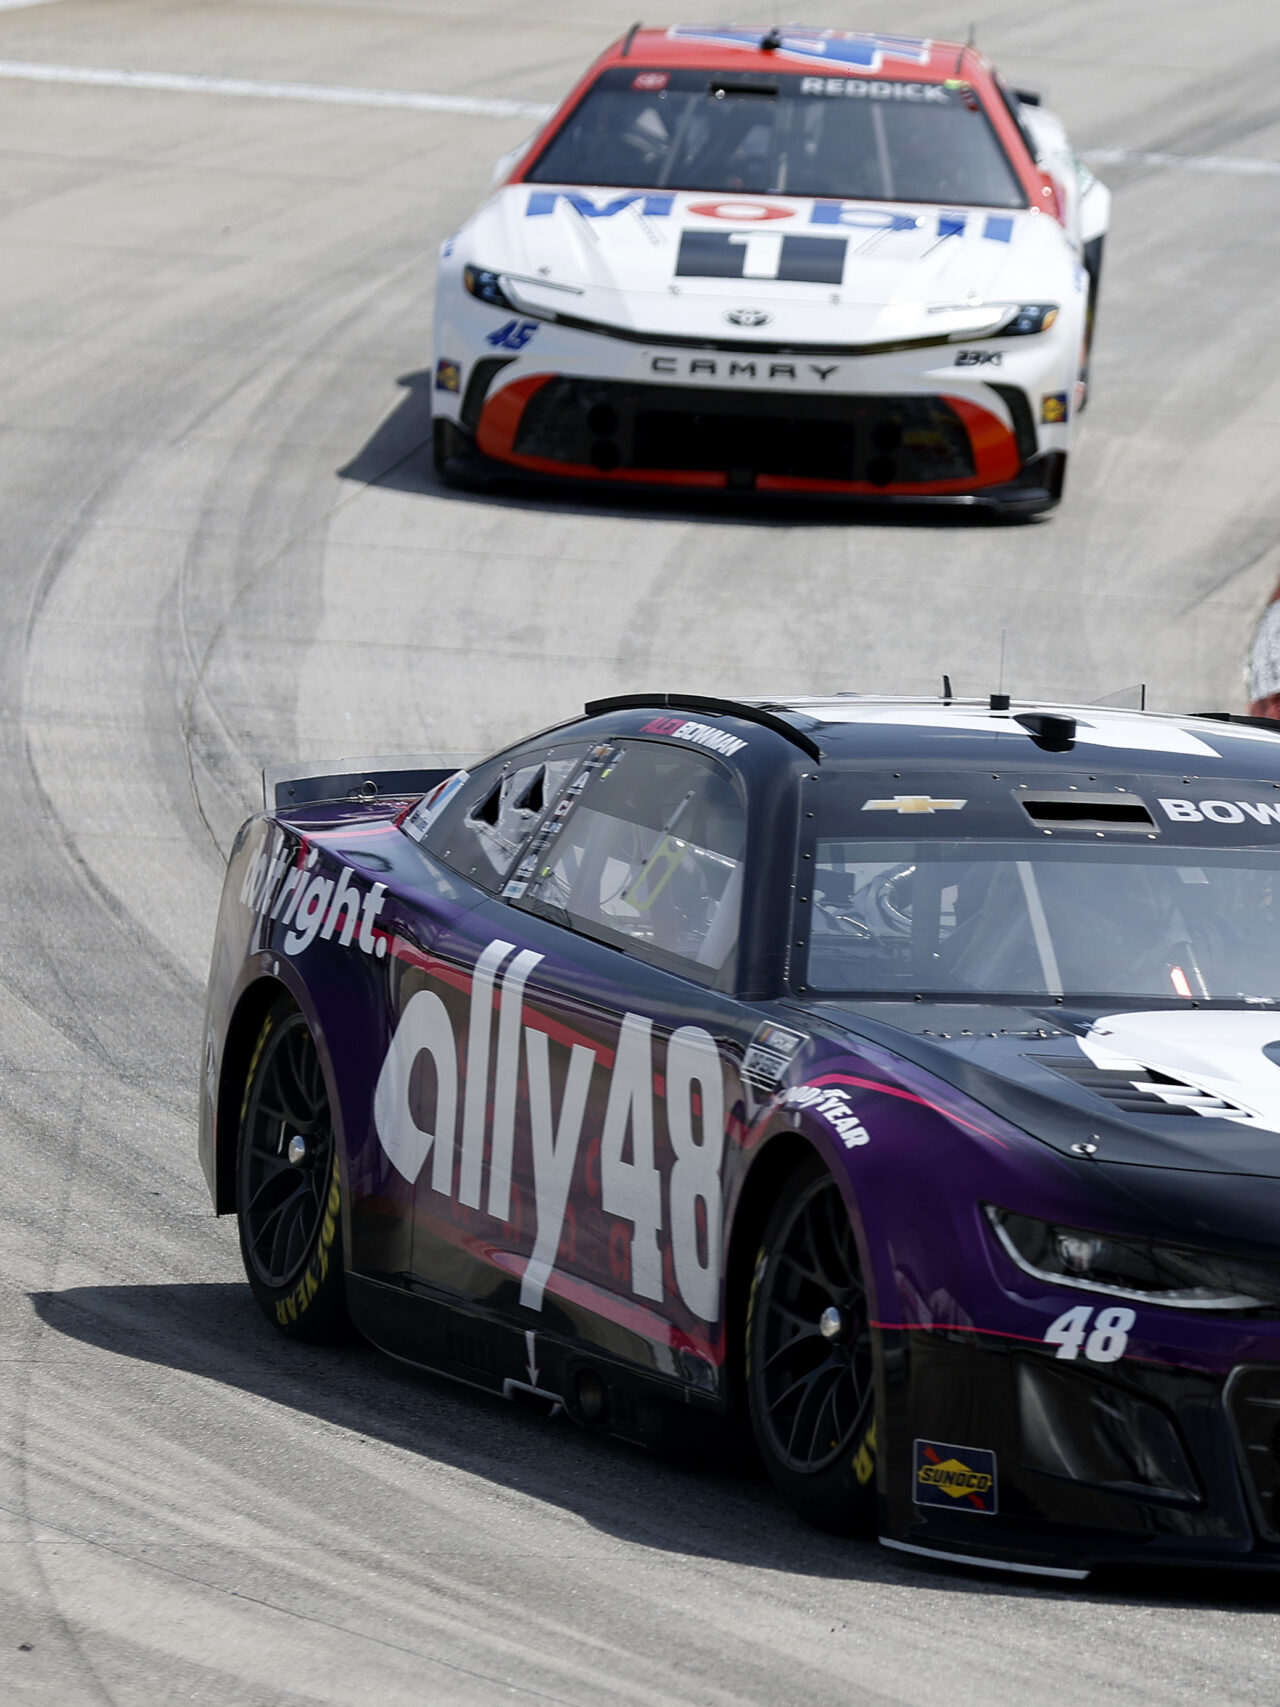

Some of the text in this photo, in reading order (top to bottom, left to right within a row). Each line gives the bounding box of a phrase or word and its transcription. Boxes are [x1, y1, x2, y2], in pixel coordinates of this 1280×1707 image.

[801, 76, 952, 104] REDDICK
[728, 230, 784, 280] 1
[485, 320, 541, 350] 45
[651, 356, 840, 381] CAMRY
[672, 721, 749, 757] BOWMAN
[270, 847, 388, 959] right.
[374, 938, 722, 1324] ally 48
[1044, 1306, 1136, 1363] 48
[921, 1466, 989, 1490] SUNOCO
